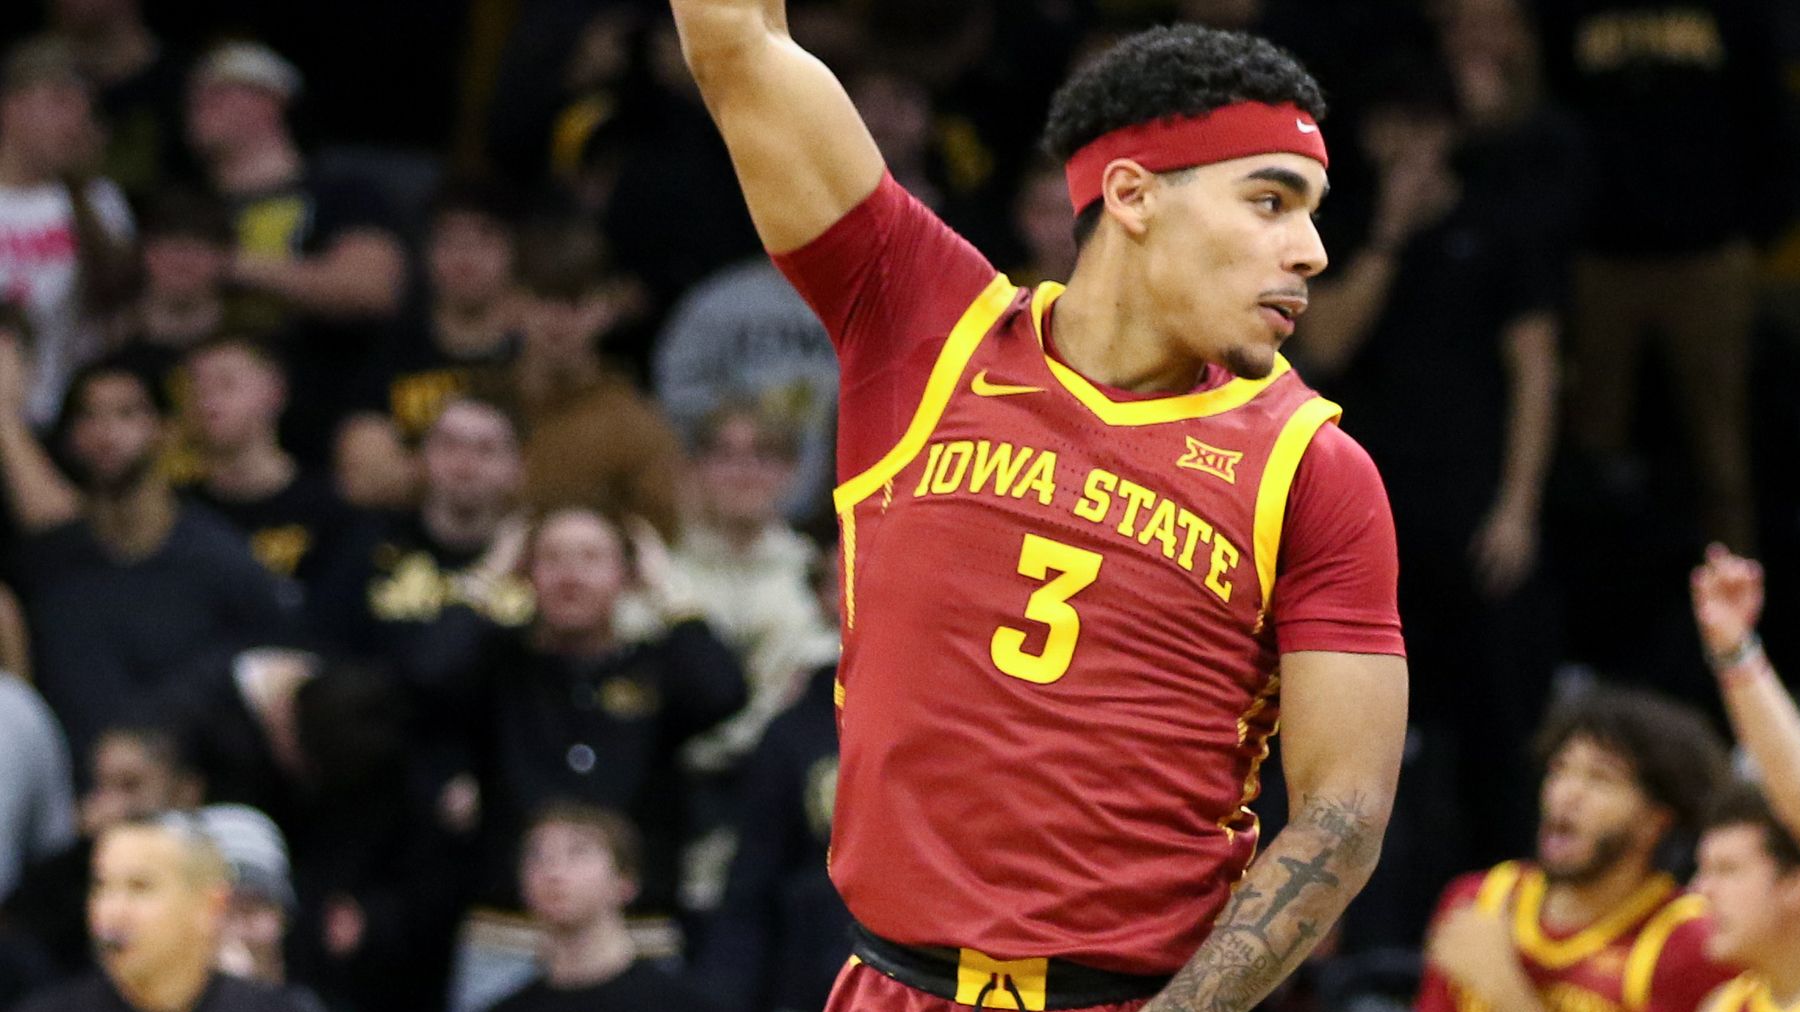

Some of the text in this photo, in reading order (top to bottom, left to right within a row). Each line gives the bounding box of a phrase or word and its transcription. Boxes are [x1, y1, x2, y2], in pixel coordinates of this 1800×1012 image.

[914, 439, 1240, 603] IOWA STATE
[989, 532, 1104, 685] 3
